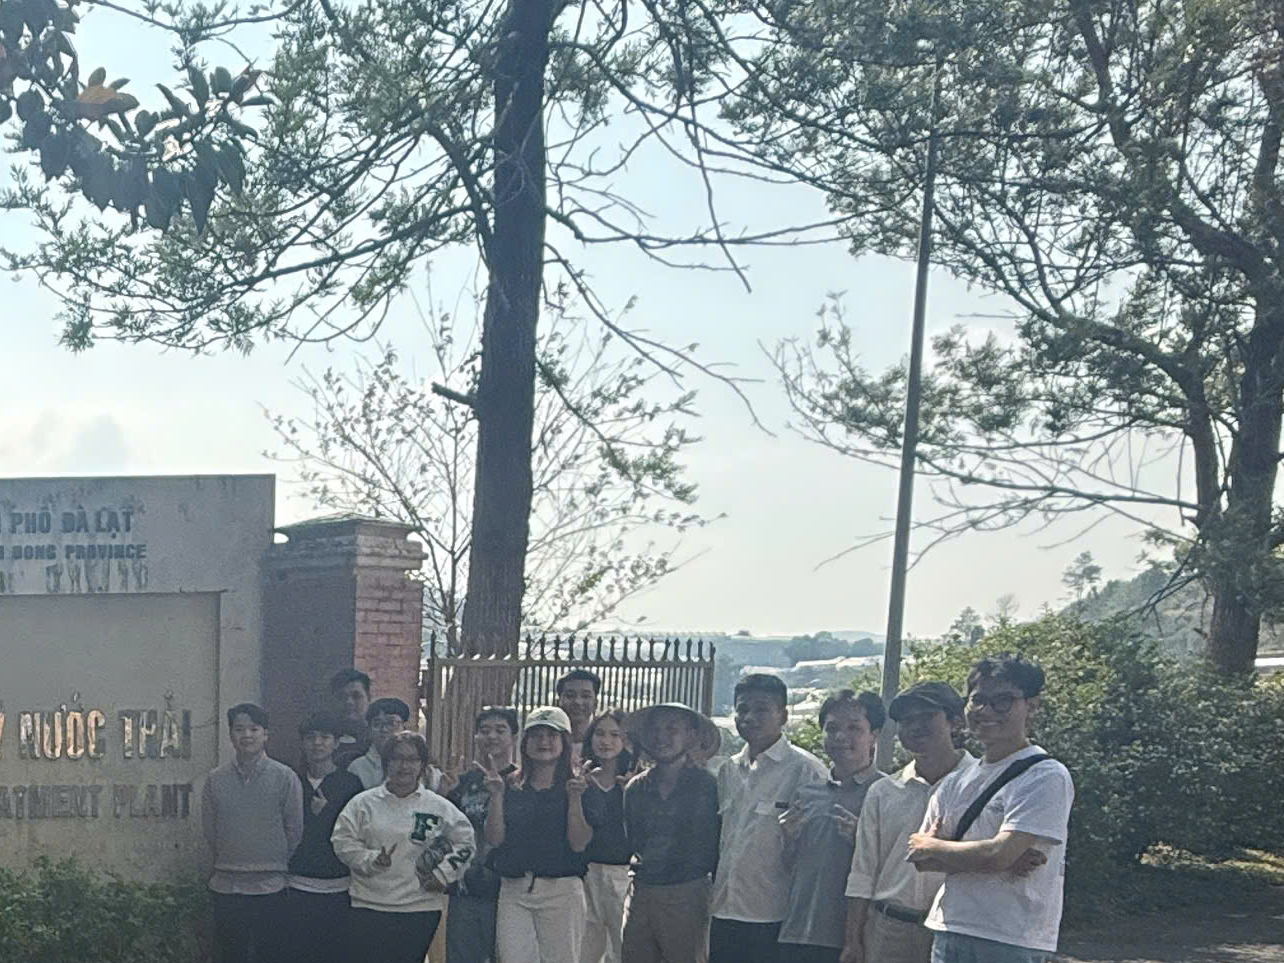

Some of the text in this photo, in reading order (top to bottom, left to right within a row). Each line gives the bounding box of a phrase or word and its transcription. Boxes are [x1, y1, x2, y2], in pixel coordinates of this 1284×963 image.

[66, 544, 147, 561] PROVINCE
[20, 692, 106, 761] NƯỚC
[113, 784, 193, 819] PLANT
